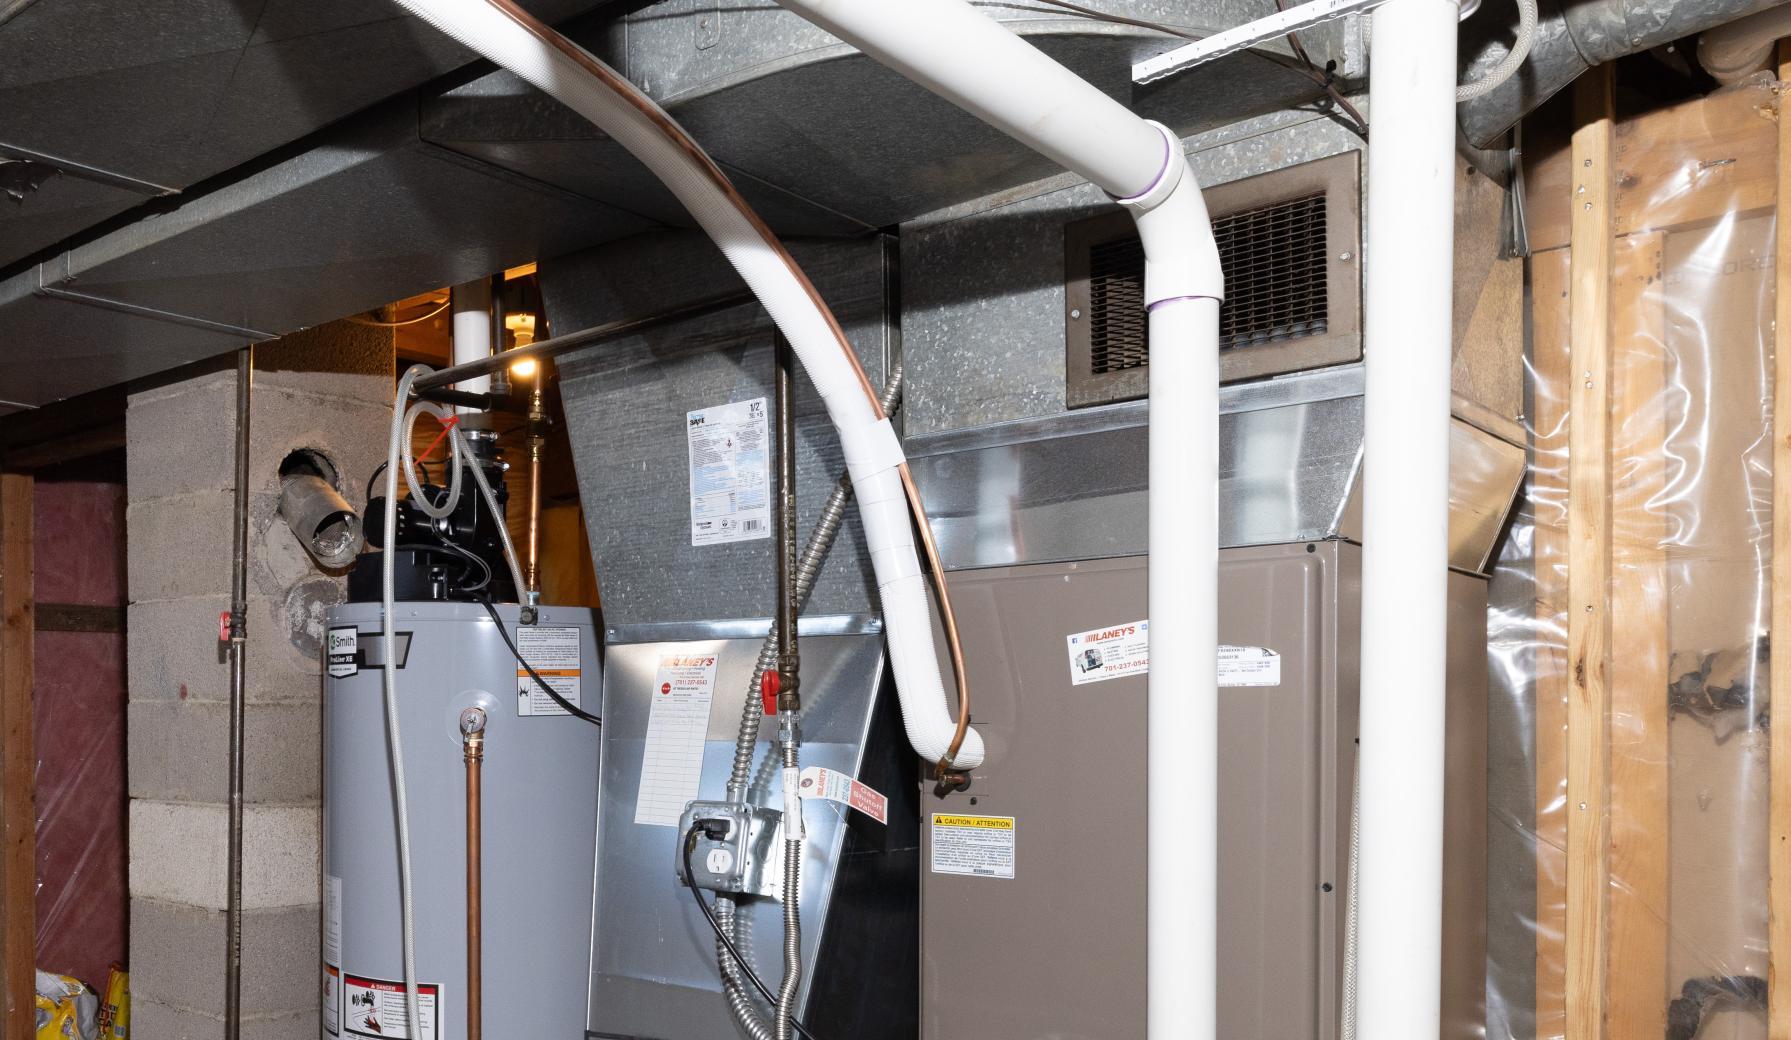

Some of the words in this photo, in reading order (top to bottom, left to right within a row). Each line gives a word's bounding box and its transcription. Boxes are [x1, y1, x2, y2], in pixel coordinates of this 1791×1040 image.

[336, 636, 355, 648] Smith
[861, 786, 876, 800] Gas
[854, 790, 883, 811] Shutoff
[858, 801, 879, 817] Valve
[976, 820, 1011, 828] ATTENTION
